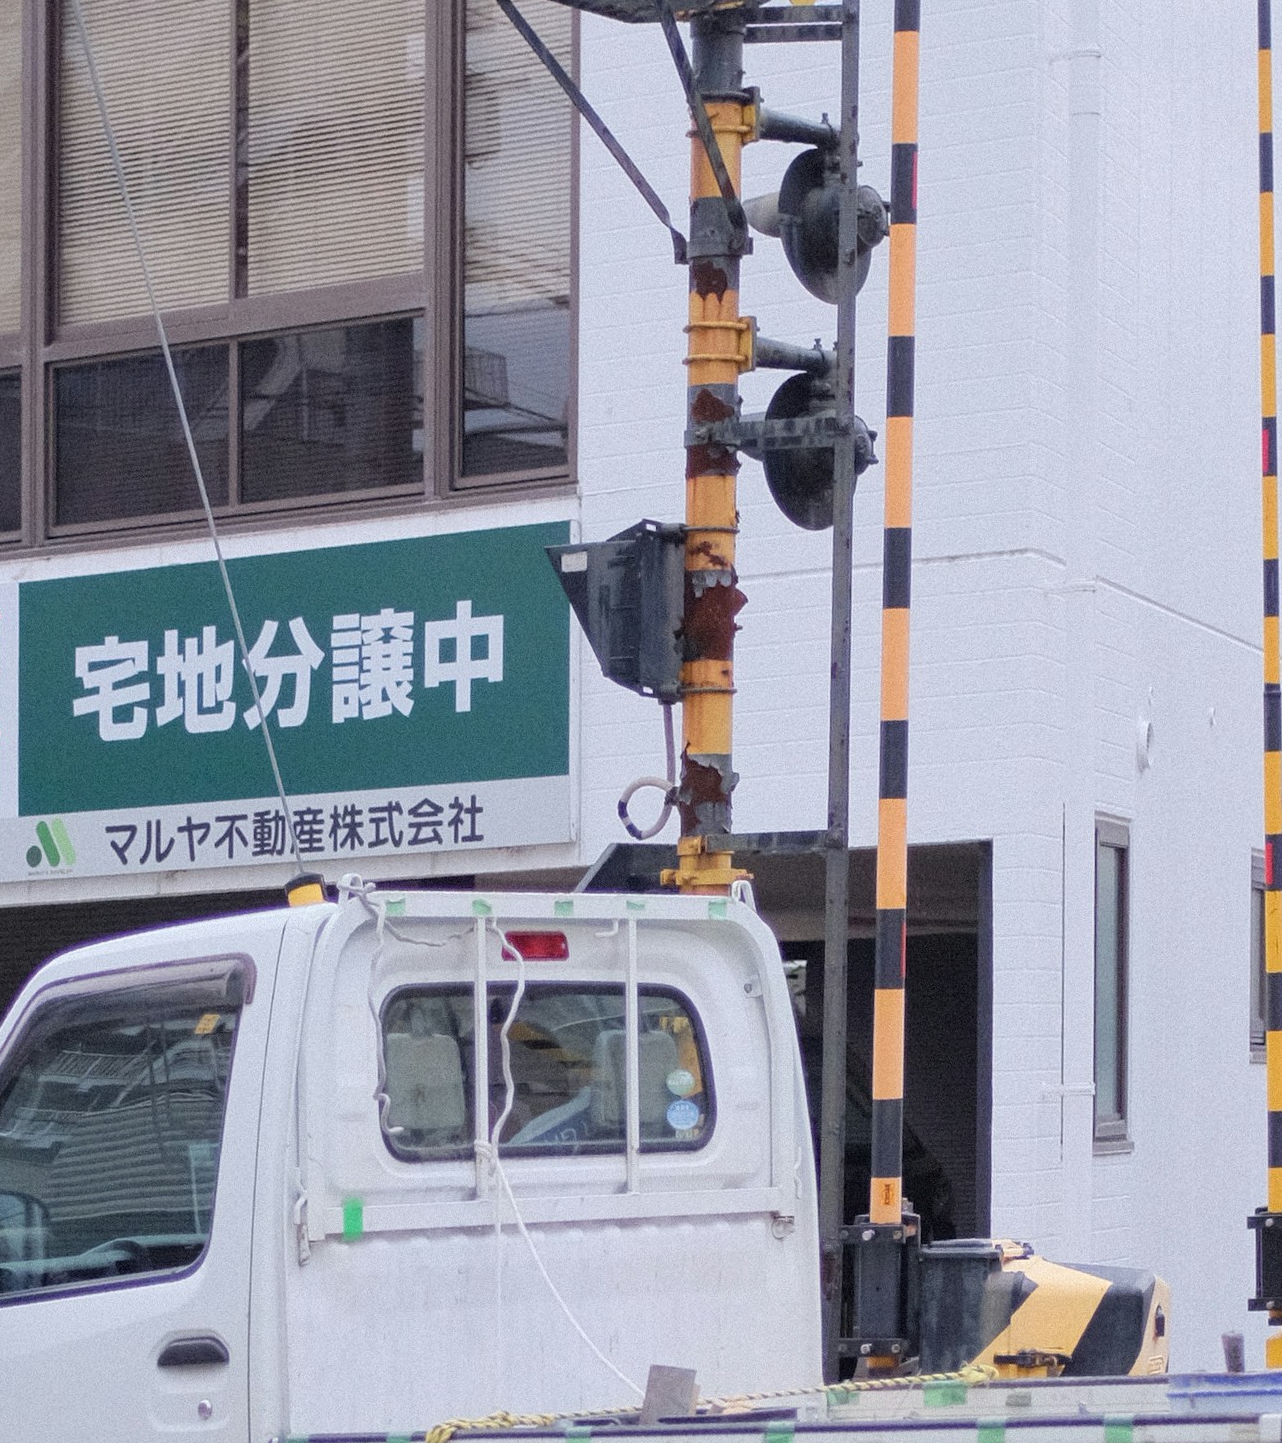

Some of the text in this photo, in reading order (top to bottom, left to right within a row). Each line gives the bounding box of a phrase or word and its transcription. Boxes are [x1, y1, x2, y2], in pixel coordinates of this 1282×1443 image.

[73, 599, 506, 743] 宅地分譲中
[105, 793, 485, 866] マルヤ不動産株式会社
